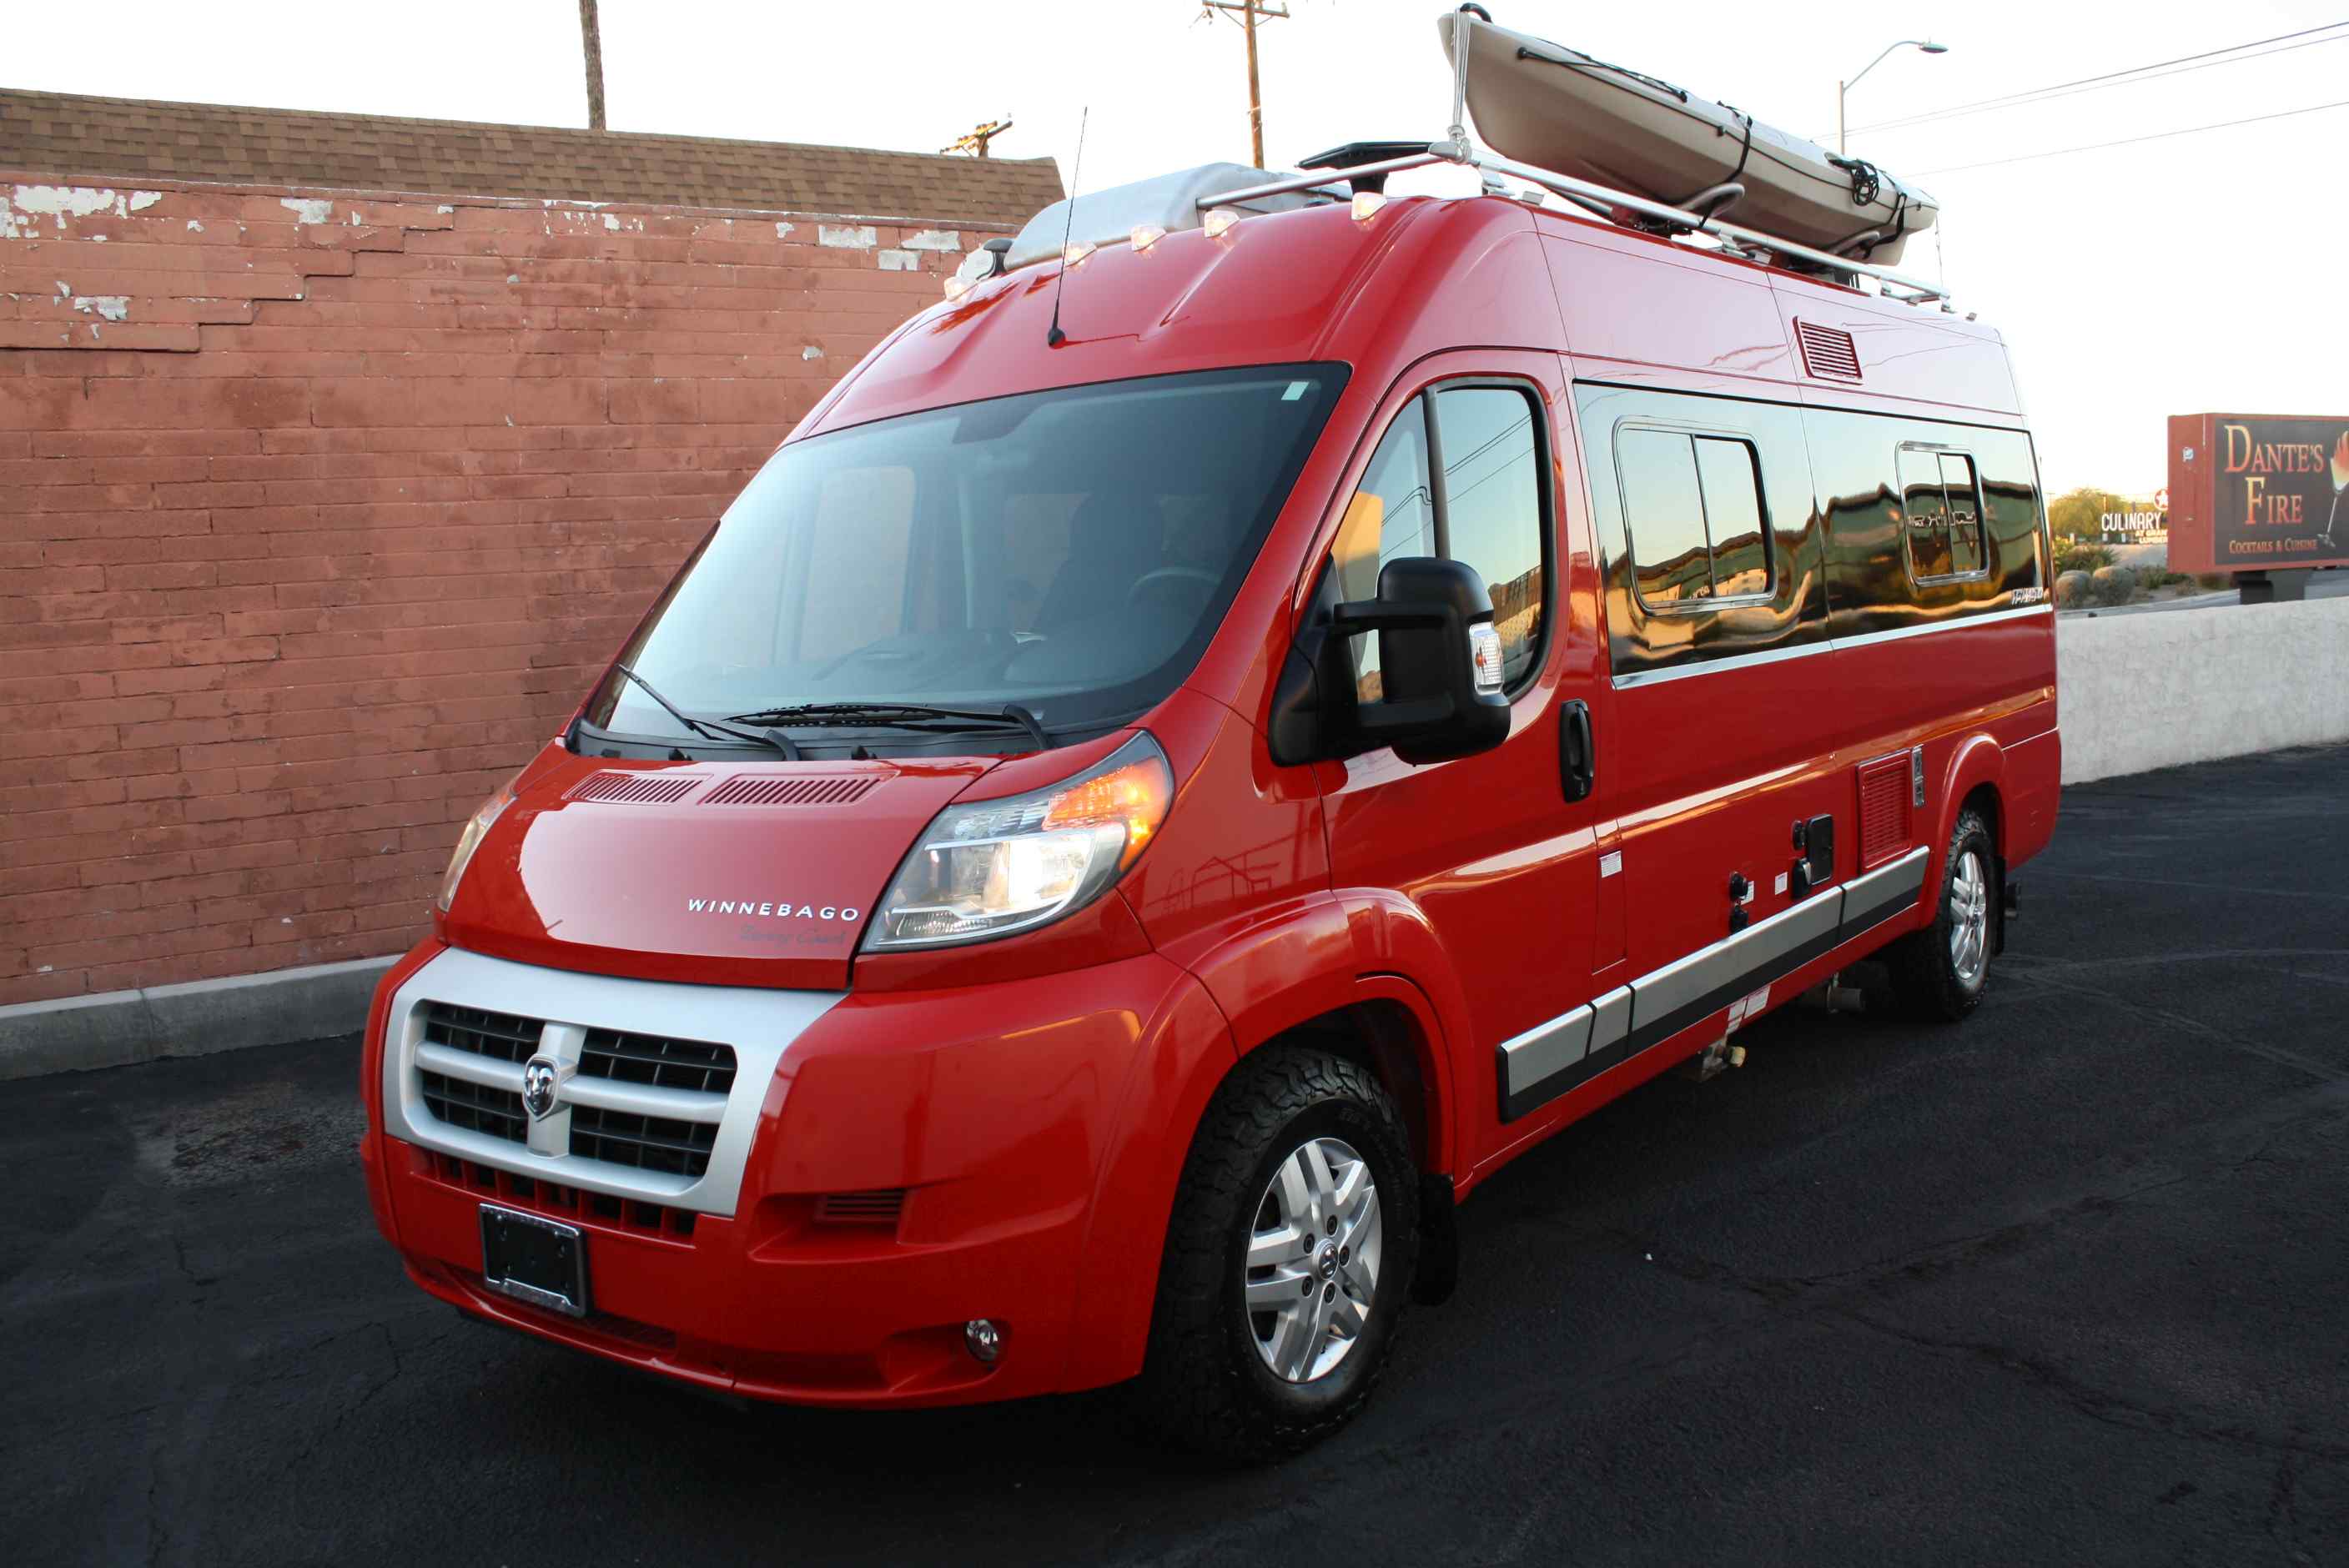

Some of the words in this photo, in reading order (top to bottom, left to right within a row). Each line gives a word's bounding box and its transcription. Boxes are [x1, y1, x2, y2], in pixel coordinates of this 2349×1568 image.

[2224, 425, 2324, 472] DANTE'S
[2245, 476, 2303, 525] FIRE
[2101, 510, 2162, 532] CULINARY
[687, 897, 859, 922] WINNEBAGO
